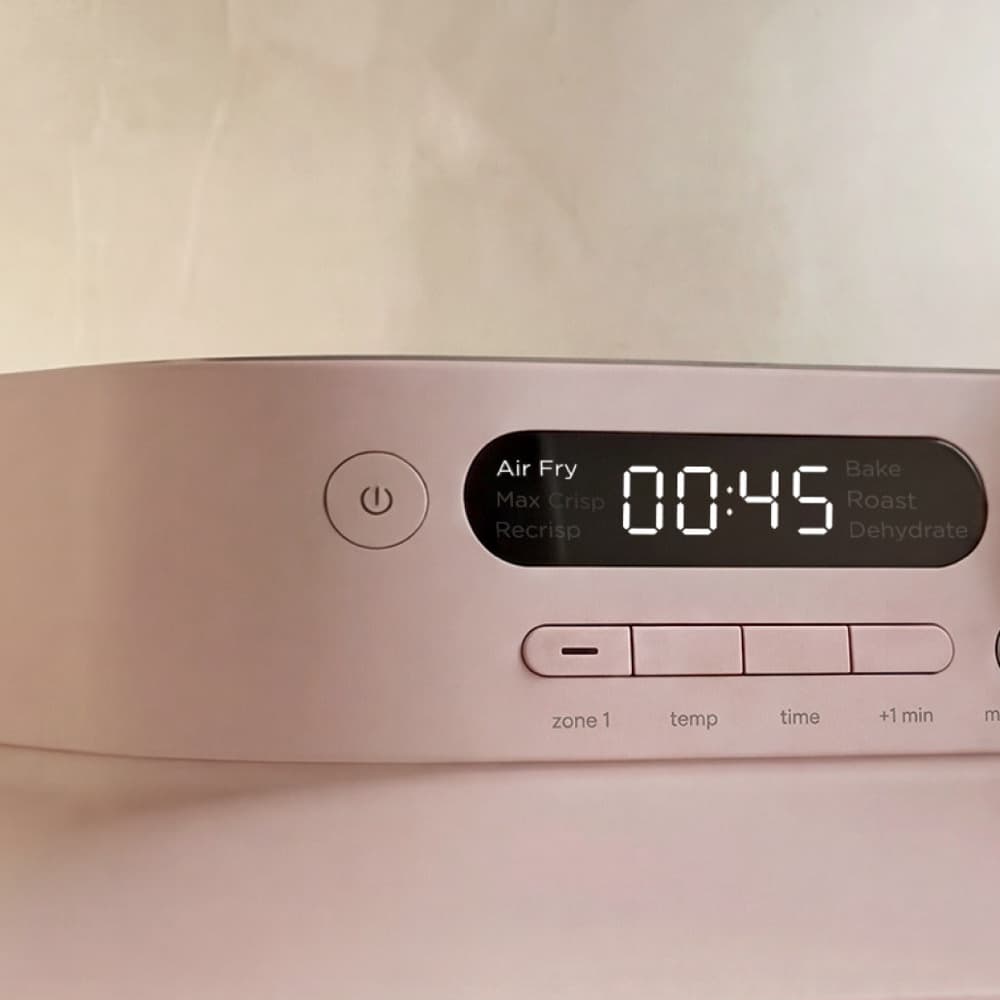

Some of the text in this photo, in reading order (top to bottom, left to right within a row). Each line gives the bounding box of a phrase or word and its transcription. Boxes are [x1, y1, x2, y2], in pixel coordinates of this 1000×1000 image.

[496, 460, 578, 481] Air Fry
[846, 460, 902, 478] Bake
[496, 491, 605, 514] Max Crisp
[622, 465, 834, 536] 00:45
[848, 490, 918, 510] Roast
[496, 521, 581, 543] Recrisp
[849, 521, 969, 544] Dehydrate
[551, 711, 610, 729] zone 1
[670, 711, 719, 730] temp
[780, 708, 820, 726] time
[879, 707, 934, 723] +1 min
